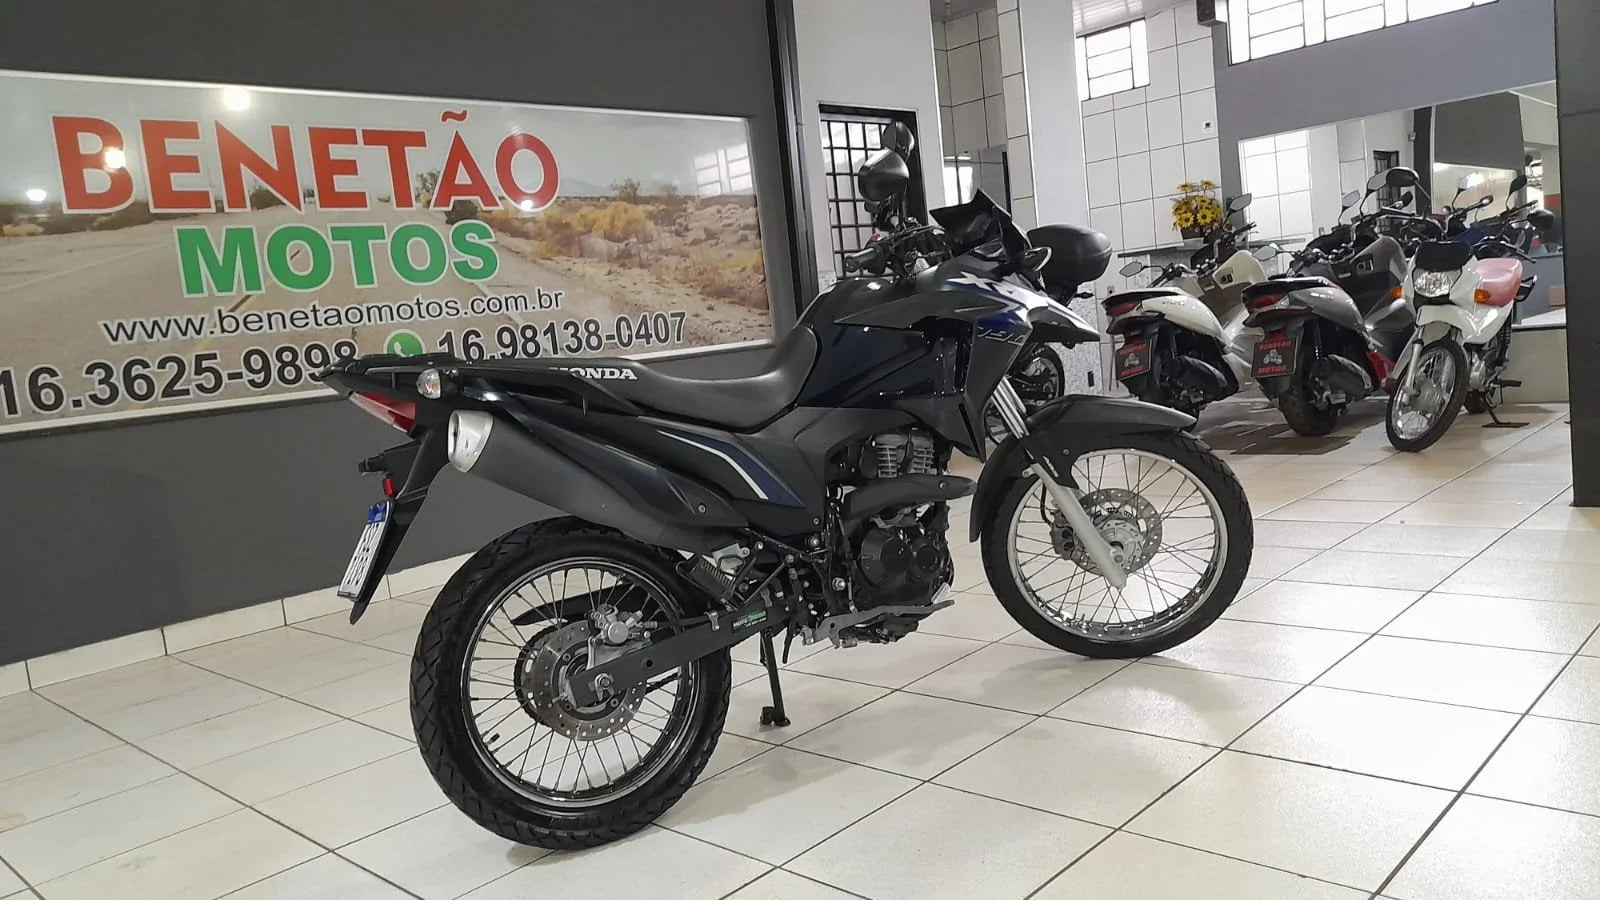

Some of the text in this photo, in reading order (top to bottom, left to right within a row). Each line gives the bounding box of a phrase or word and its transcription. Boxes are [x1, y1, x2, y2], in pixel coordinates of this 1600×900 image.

[53, 110, 560, 210] BENETÃO
[176, 221, 500, 295] MOTOS
[103, 288, 564, 342] www.benetaomotos.com.br
[438, 311, 686, 360] 16.98138-0407
[549, 367, 638, 380] ONDA
